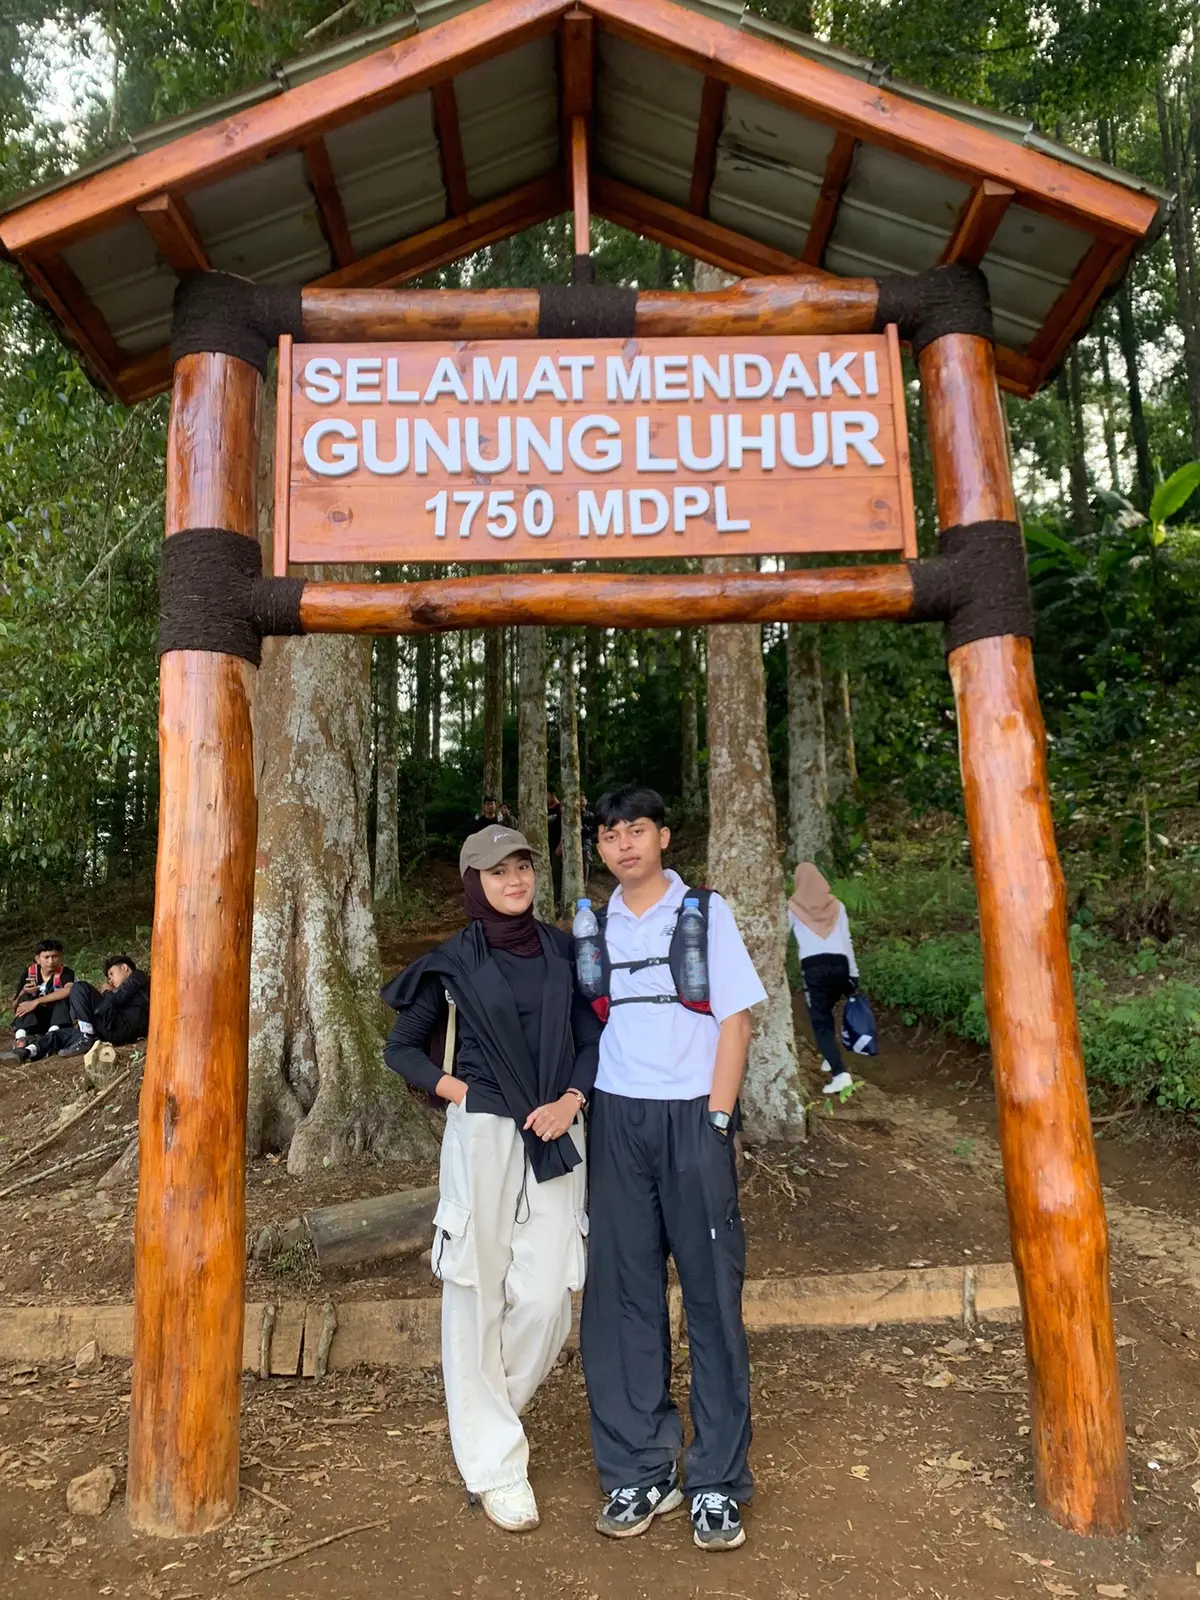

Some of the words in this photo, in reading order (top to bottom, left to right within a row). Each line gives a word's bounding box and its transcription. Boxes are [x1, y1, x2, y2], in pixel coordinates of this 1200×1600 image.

[303, 355, 595, 404] SELAMAT
[605, 350, 880, 402] MENDAKI
[302, 414, 624, 476] GUNUNG
[635, 410, 886, 474] LUHUR
[424, 488, 555, 539] 1750
[577, 485, 752, 537] MDPL
